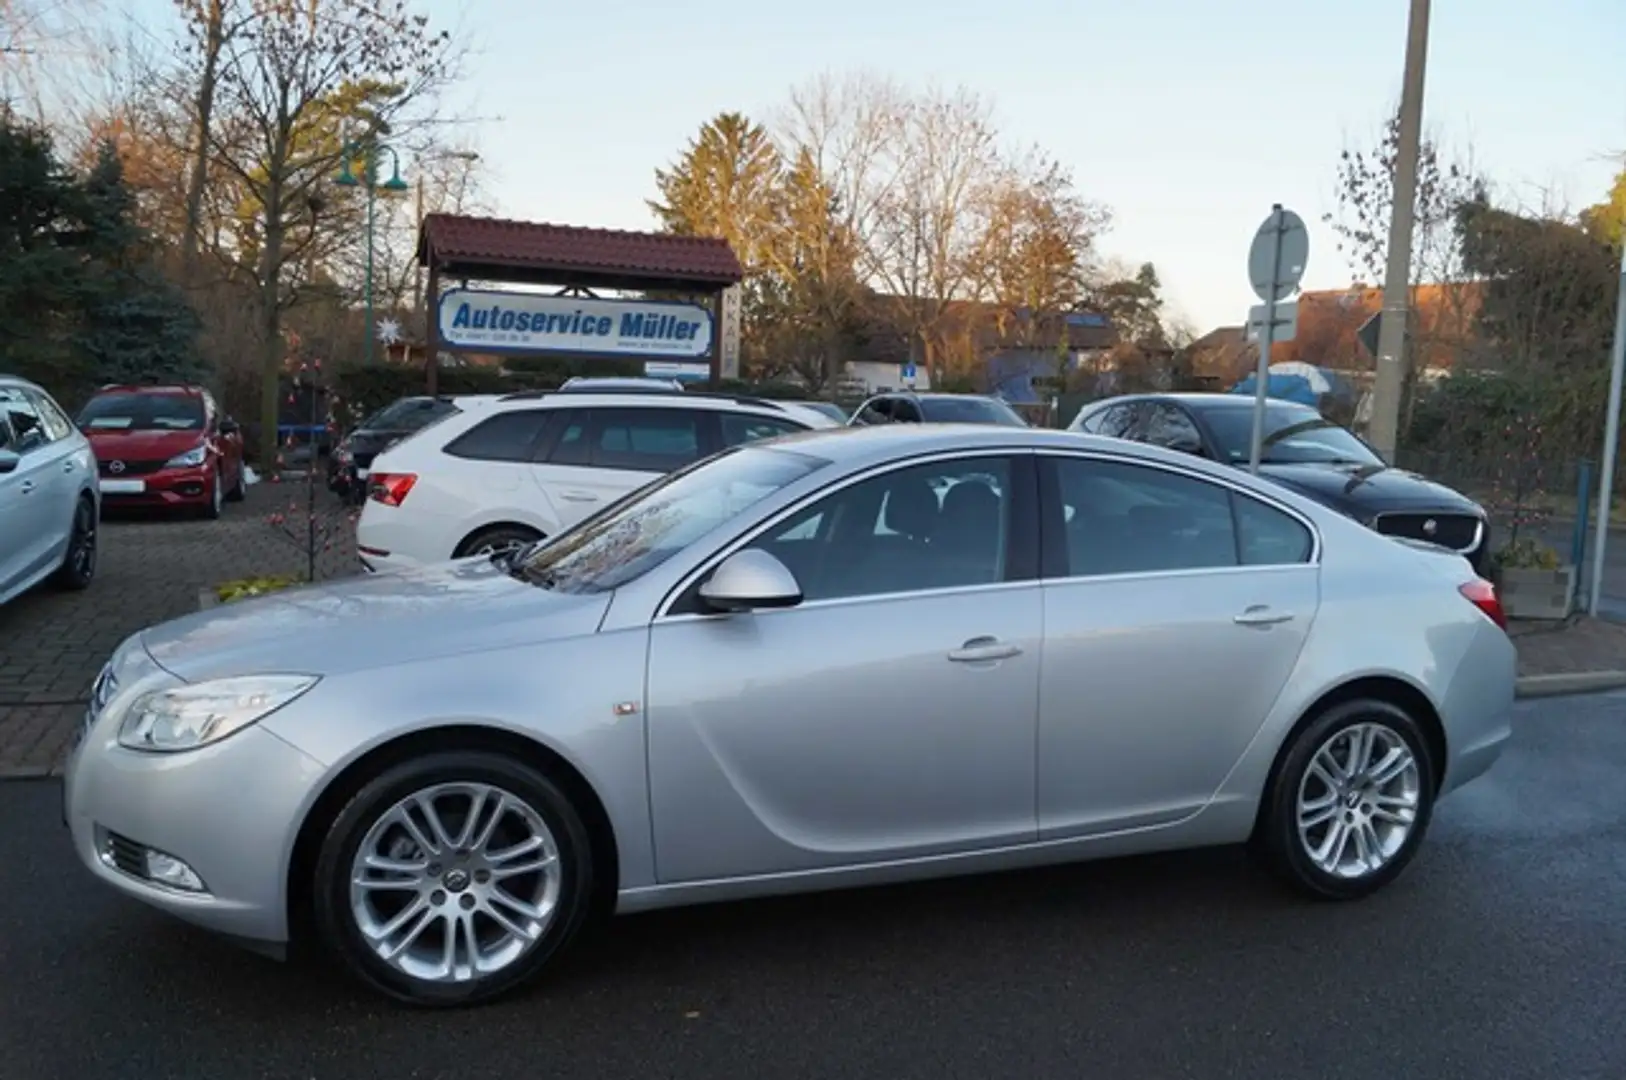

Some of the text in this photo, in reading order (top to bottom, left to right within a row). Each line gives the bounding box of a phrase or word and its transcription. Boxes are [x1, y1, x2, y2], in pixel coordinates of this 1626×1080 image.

[452, 302, 701, 341] Autoservice Müller
[724, 284, 739, 373] NKAUF
